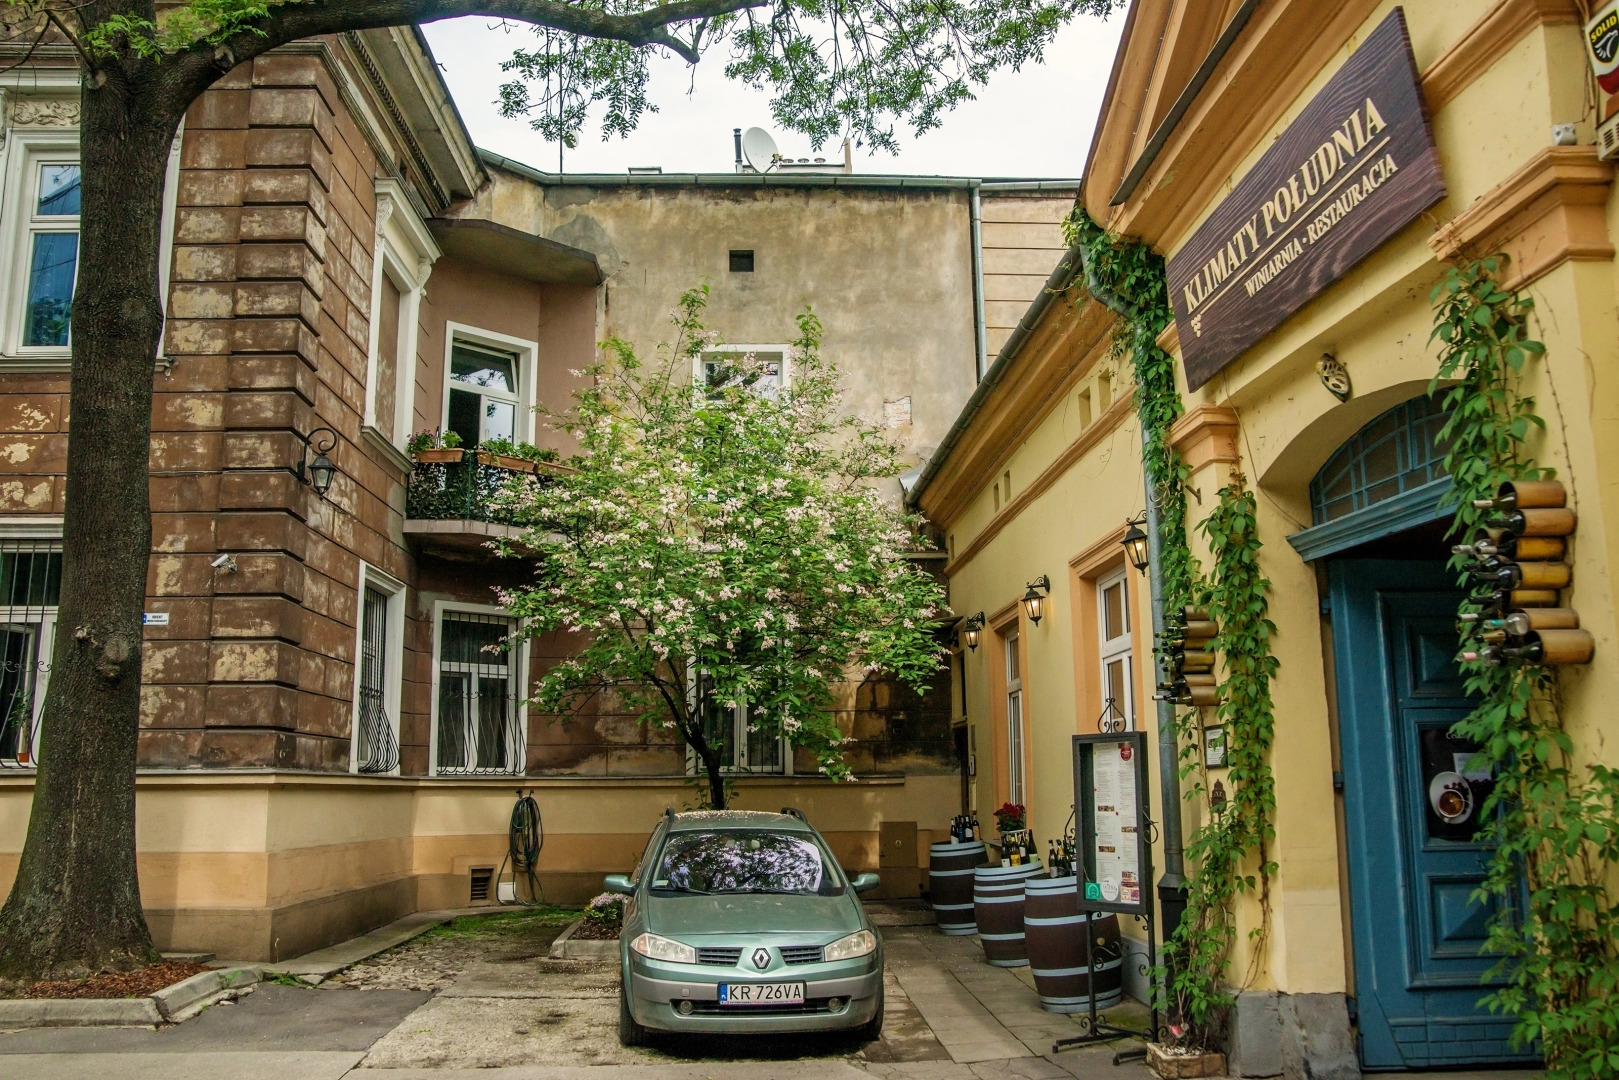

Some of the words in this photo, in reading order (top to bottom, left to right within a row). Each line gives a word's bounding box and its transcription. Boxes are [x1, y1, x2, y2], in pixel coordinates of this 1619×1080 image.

[1590, 15, 1617, 42] SOLID
[1183, 214, 1260, 315] KLIMATY
[1260, 97, 1387, 239] POŁUDNIA
[1244, 238, 1304, 298] WINIARNIA
[1305, 153, 1398, 246] RESTAURACJA
[729, 985, 751, 1000] KR
[756, 984, 802, 1000] 726VA
